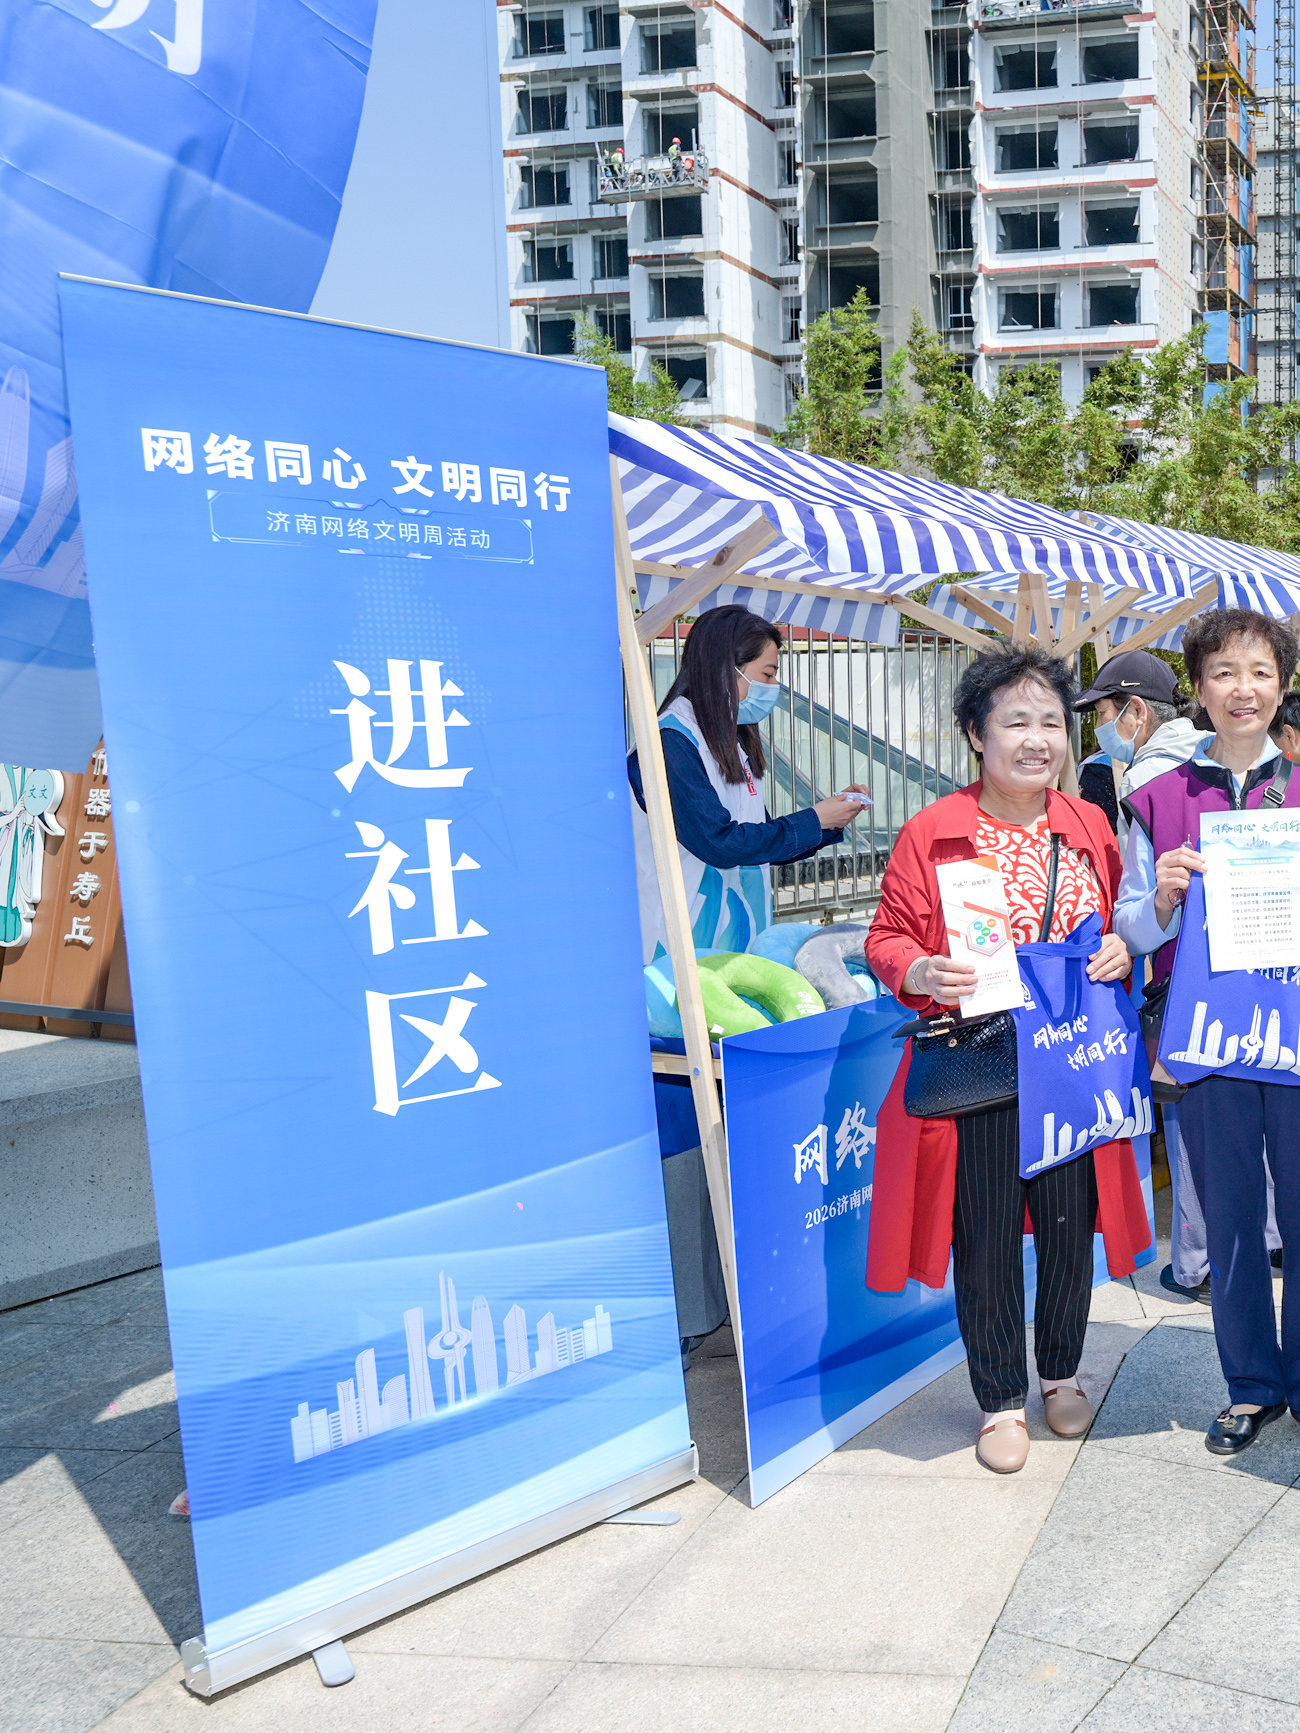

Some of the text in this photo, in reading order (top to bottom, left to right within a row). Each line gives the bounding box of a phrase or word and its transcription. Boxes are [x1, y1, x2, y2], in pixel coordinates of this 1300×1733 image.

[140, 427, 572, 512] 网络同心 文明同行
[265, 509, 491, 550] 济南网络文明周活动
[1211, 819, 1300, 835] 网络同心 文明同行
[329, 658, 503, 1117] 进社区
[792, 1101, 877, 1186] 网络
[804, 1183, 873, 1229] 2026济南网
